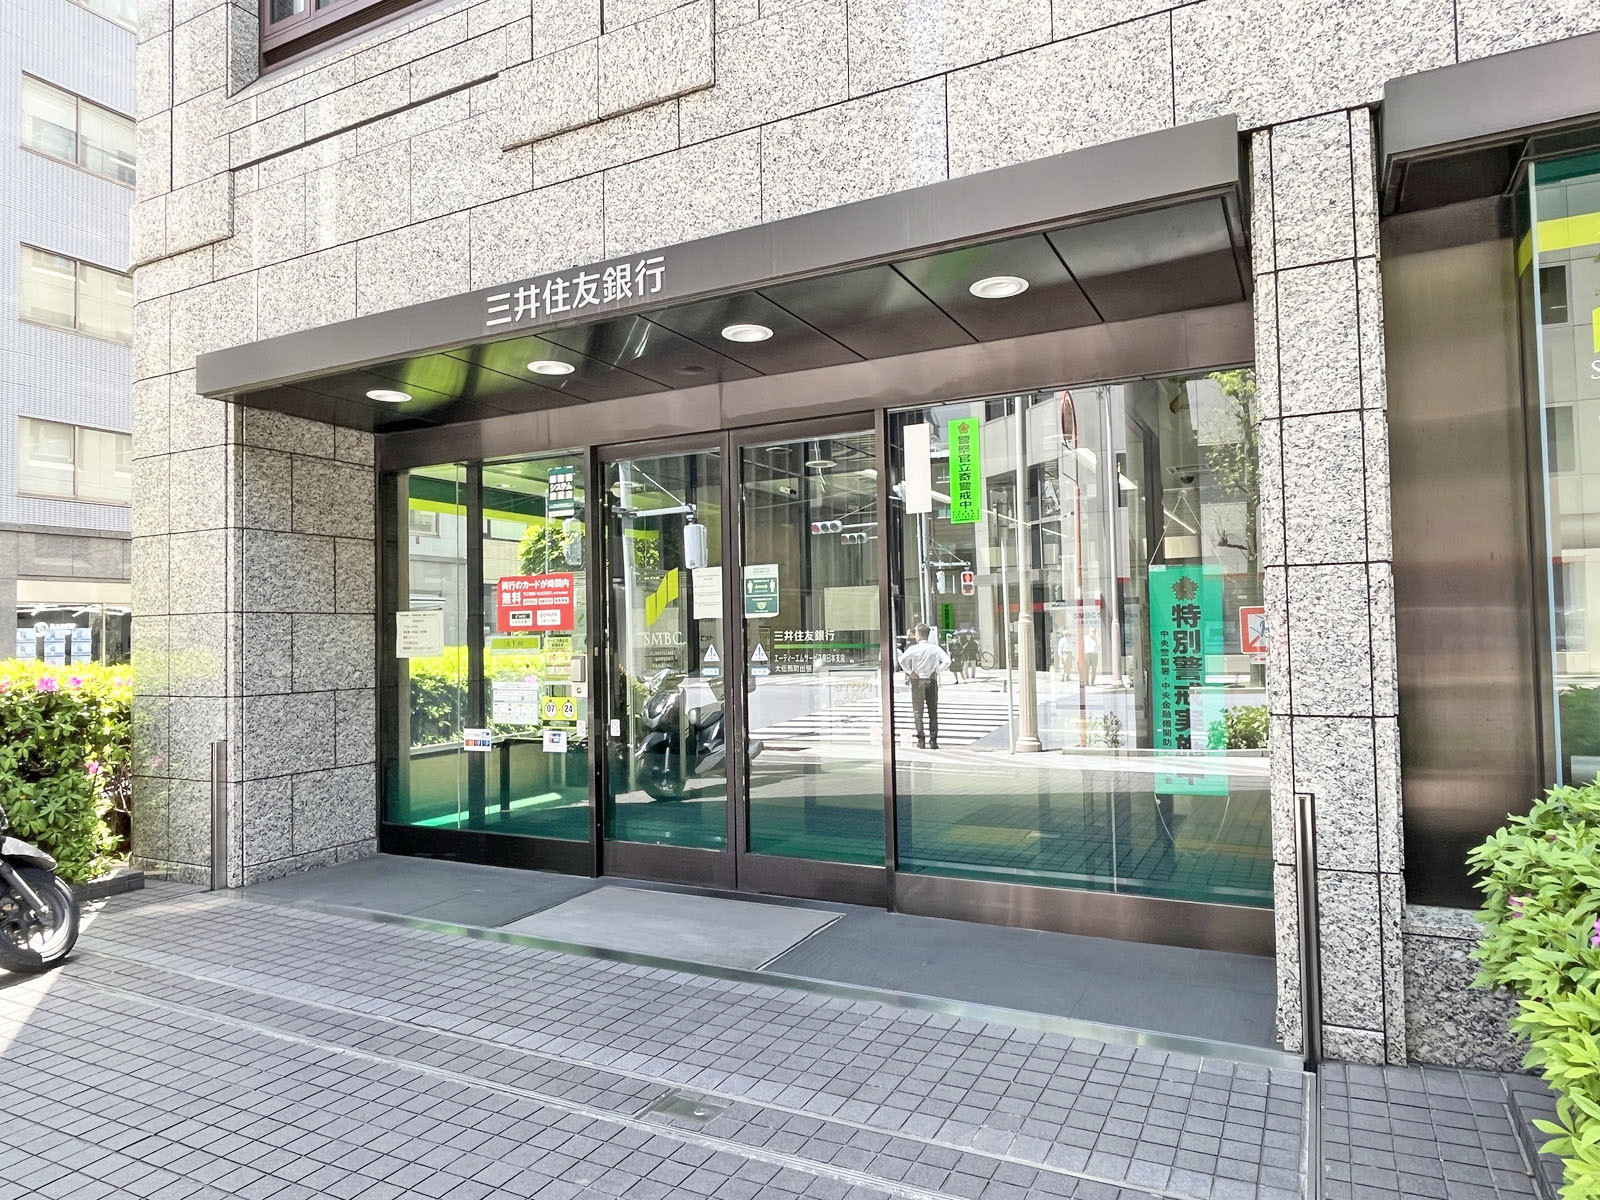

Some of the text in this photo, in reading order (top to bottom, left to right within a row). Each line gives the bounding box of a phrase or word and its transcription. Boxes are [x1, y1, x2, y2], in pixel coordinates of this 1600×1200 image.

[486, 256, 666, 327] 三井住友銀行
[957, 434, 972, 510] 警察官立寄警戒中
[502, 591, 521, 604] 無料
[644, 631, 682, 646] SMBC
[774, 630, 836, 642] 三井住友銀行
[546, 705, 573, 713] 07 24
